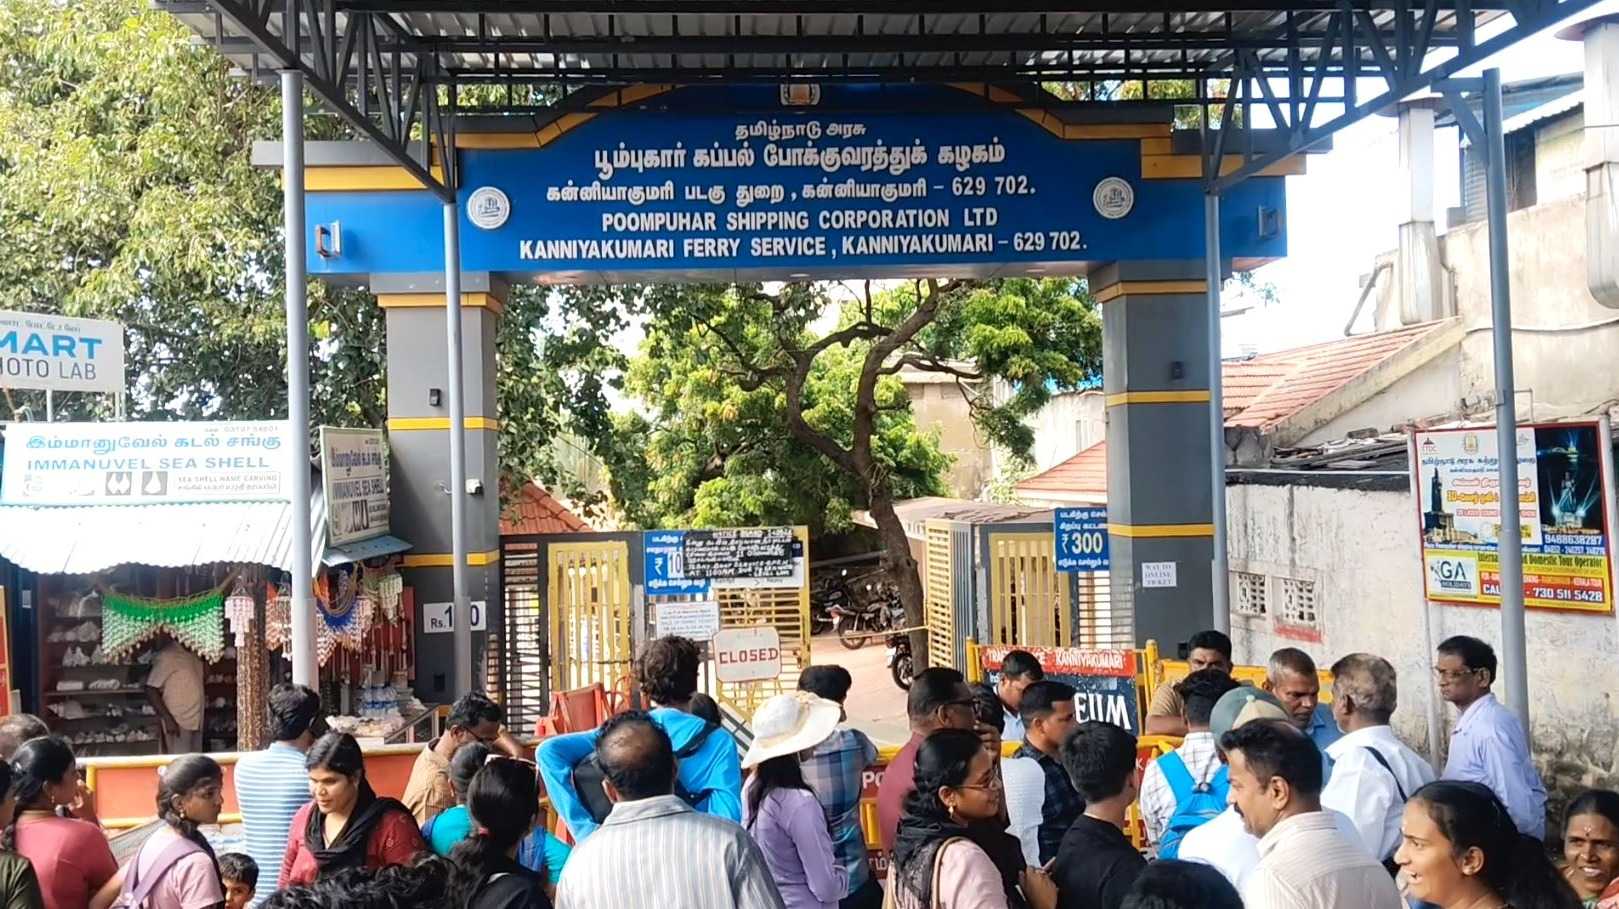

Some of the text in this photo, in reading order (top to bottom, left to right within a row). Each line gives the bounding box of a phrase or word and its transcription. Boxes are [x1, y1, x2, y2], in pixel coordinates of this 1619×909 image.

[735, 121, 867, 143] தமிழ்நாடு அரசு
[595, 138, 1006, 179] பூம்புகார் கப்பல் போக்குவரத்துக் கழகம்
[546, 181, 675, 206] கன்னியாகுமரி
[685, 184, 726, 204] படகு
[801, 178, 927, 203] கன்னியாகுமரி
[952, 177, 986, 195] 629
[602, 208, 999, 232] POOMPUHAR SHIPPING CORPORATION LTD
[519, 238, 676, 260] KANNIYAKUMARI
[682, 238, 742, 258] FERRY
[841, 234, 994, 256] KANNIYAKUMARI
[1013, 233, 1046, 252] 629
[60, 361, 97, 381] LAB
[26, 433, 282, 455] இம்மானுவேல் கடல் சங்கு
[27, 457, 270, 472] IMMANUVEL SEA SHELL
[1072, 532, 1104, 554] 300
[1532, 587, 1555, 599] 730
[1573, 590, 1604, 602] 5428
[719, 647, 779, 665] CLOSED
